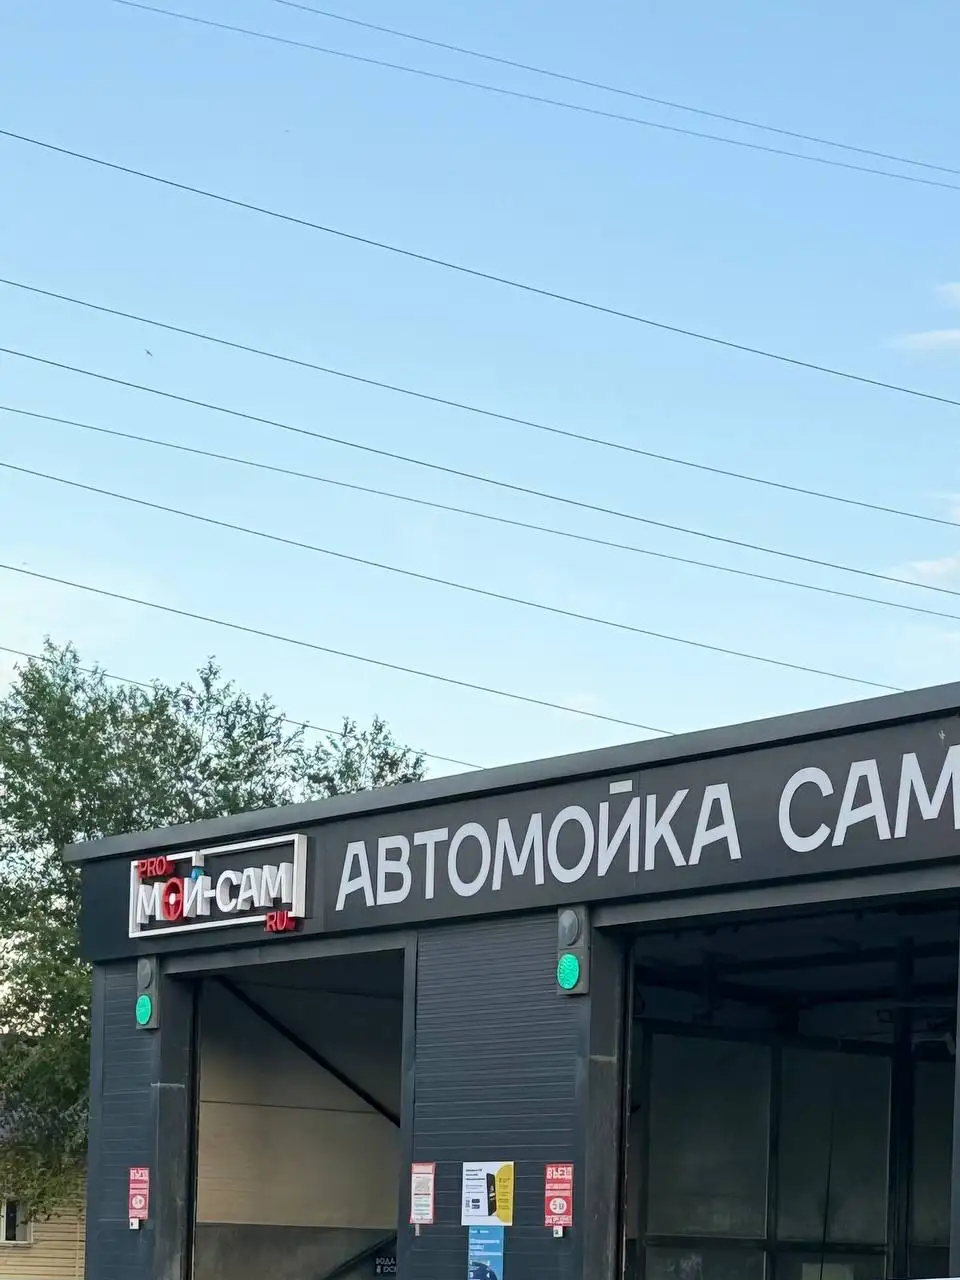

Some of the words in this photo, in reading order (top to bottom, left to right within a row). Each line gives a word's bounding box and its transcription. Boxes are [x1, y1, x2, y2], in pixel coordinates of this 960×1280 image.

[335, 780, 742, 911] АВТОМОЙКА
[137, 856, 167, 877] PRO
[137, 862, 293, 924] МОЙ-САМ
[266, 911, 288, 931] RU
